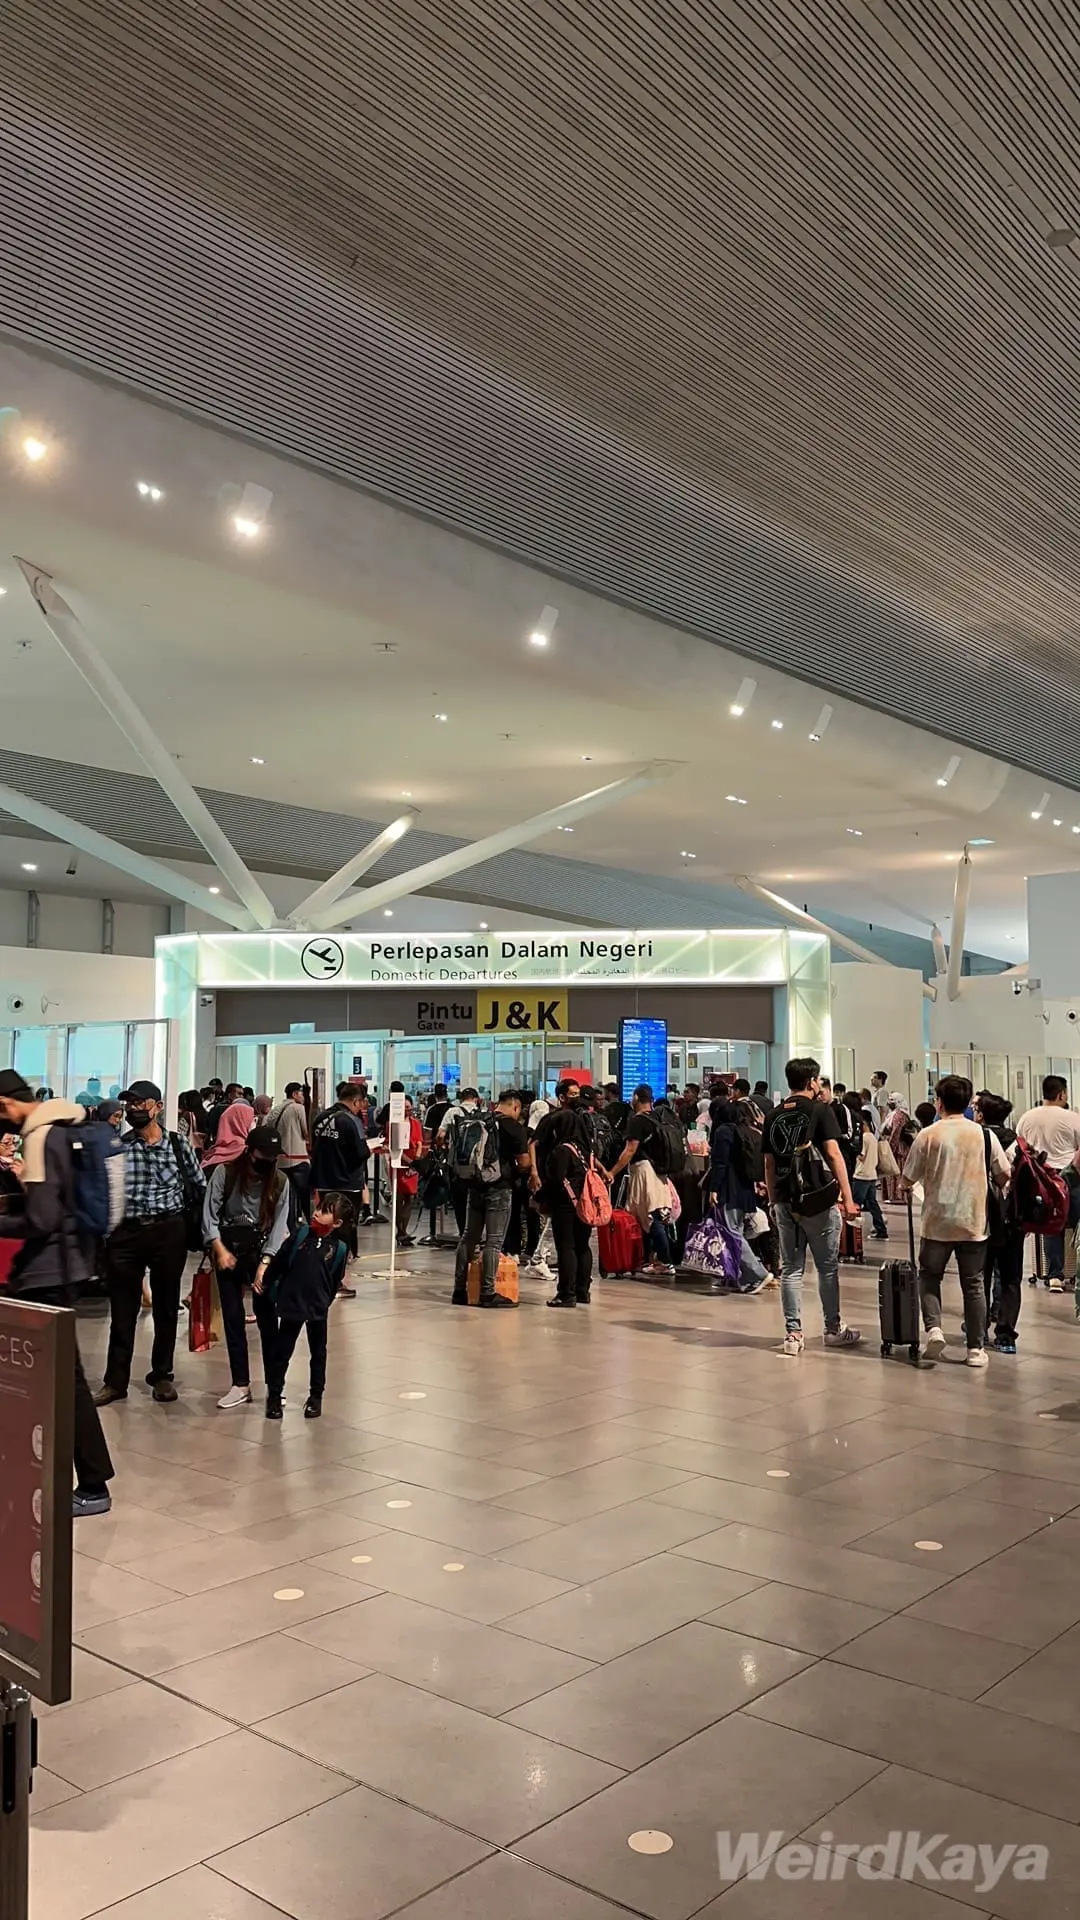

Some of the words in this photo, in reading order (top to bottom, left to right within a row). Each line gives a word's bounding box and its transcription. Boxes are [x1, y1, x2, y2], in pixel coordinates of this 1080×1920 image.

[370, 941, 489, 964] Perlepasan
[501, 940, 569, 959] Dalam
[580, 940, 653, 962] Negeri
[371, 968, 435, 981] Domestic
[439, 968, 518, 981] Departures
[417, 1001, 473, 1020] Pintu
[484, 1000, 561, 1030] J&K
[417, 1020, 446, 1031] Gate
[354, 1063, 360, 1074] 3
